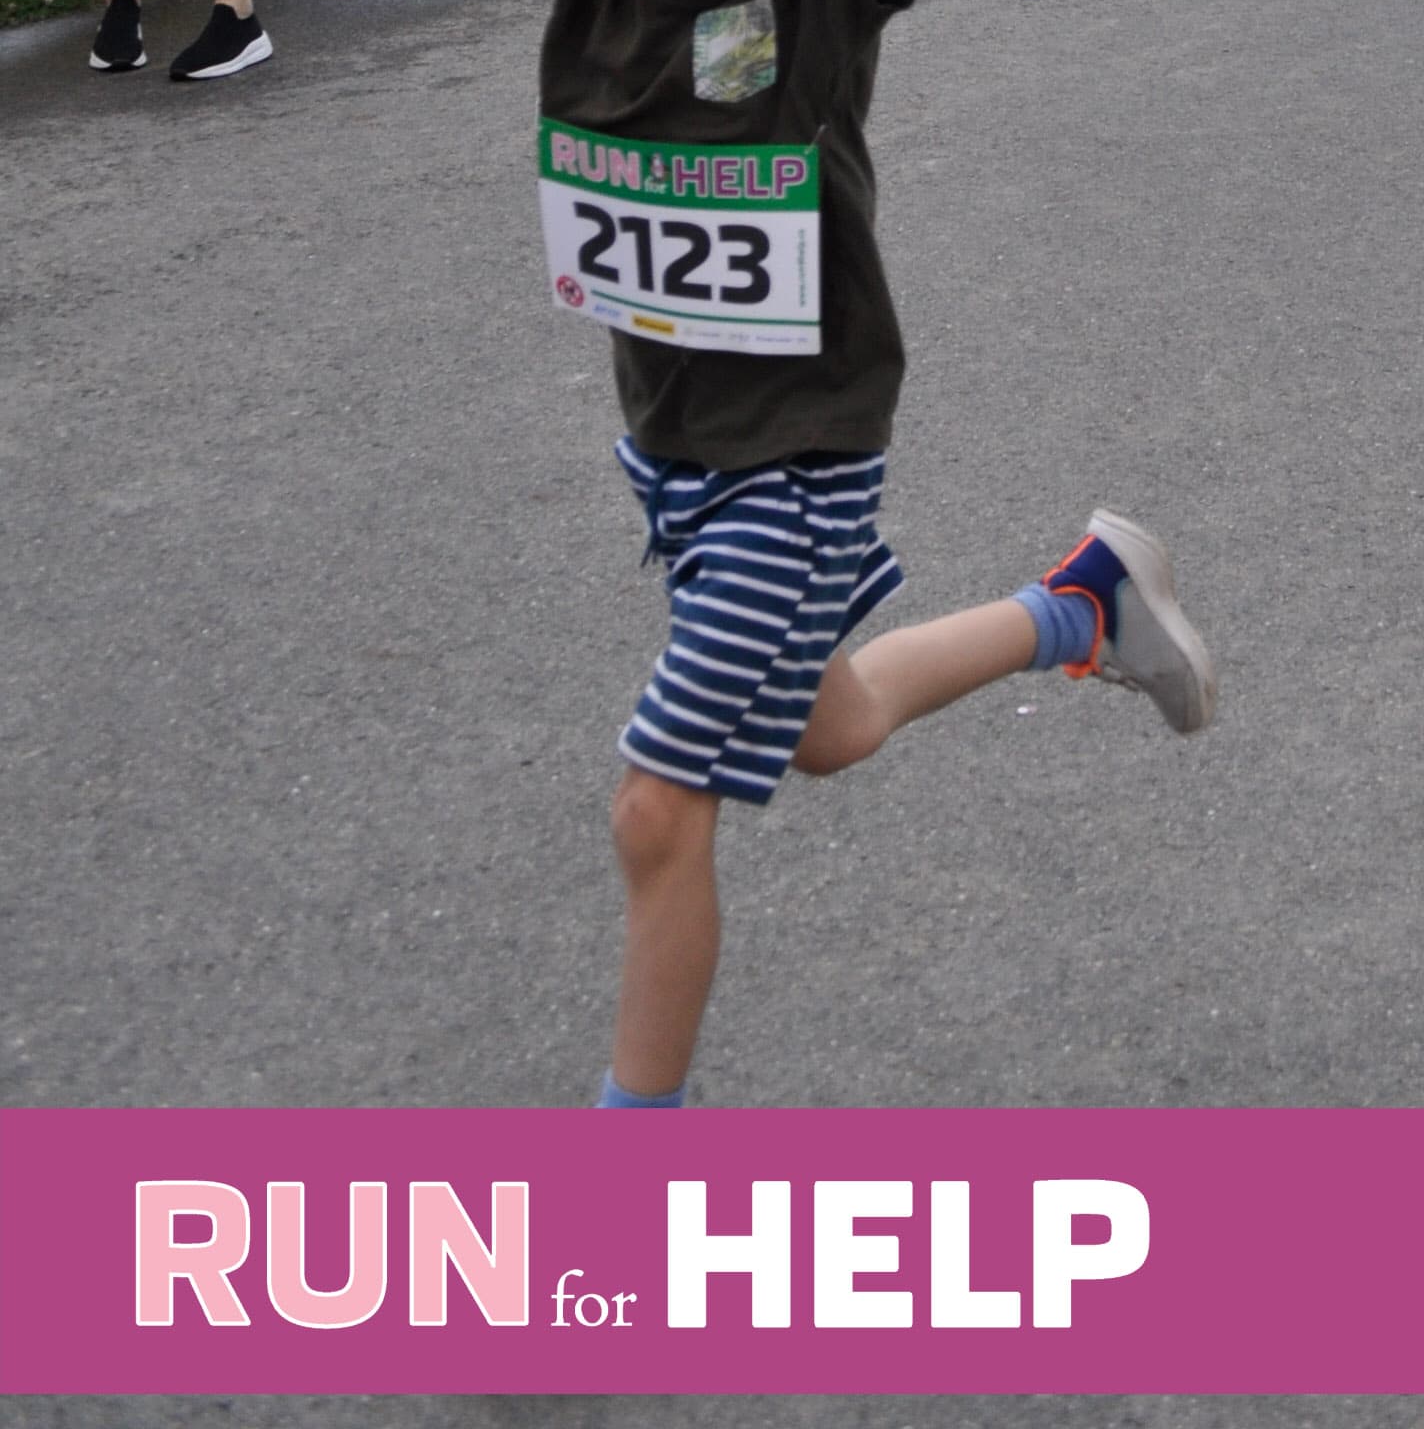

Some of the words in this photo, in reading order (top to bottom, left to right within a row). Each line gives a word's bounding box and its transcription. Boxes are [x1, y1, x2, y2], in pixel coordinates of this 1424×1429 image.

[550, 132, 641, 190] RUN
[672, 154, 808, 200] HELP
[573, 201, 771, 306] 2123
